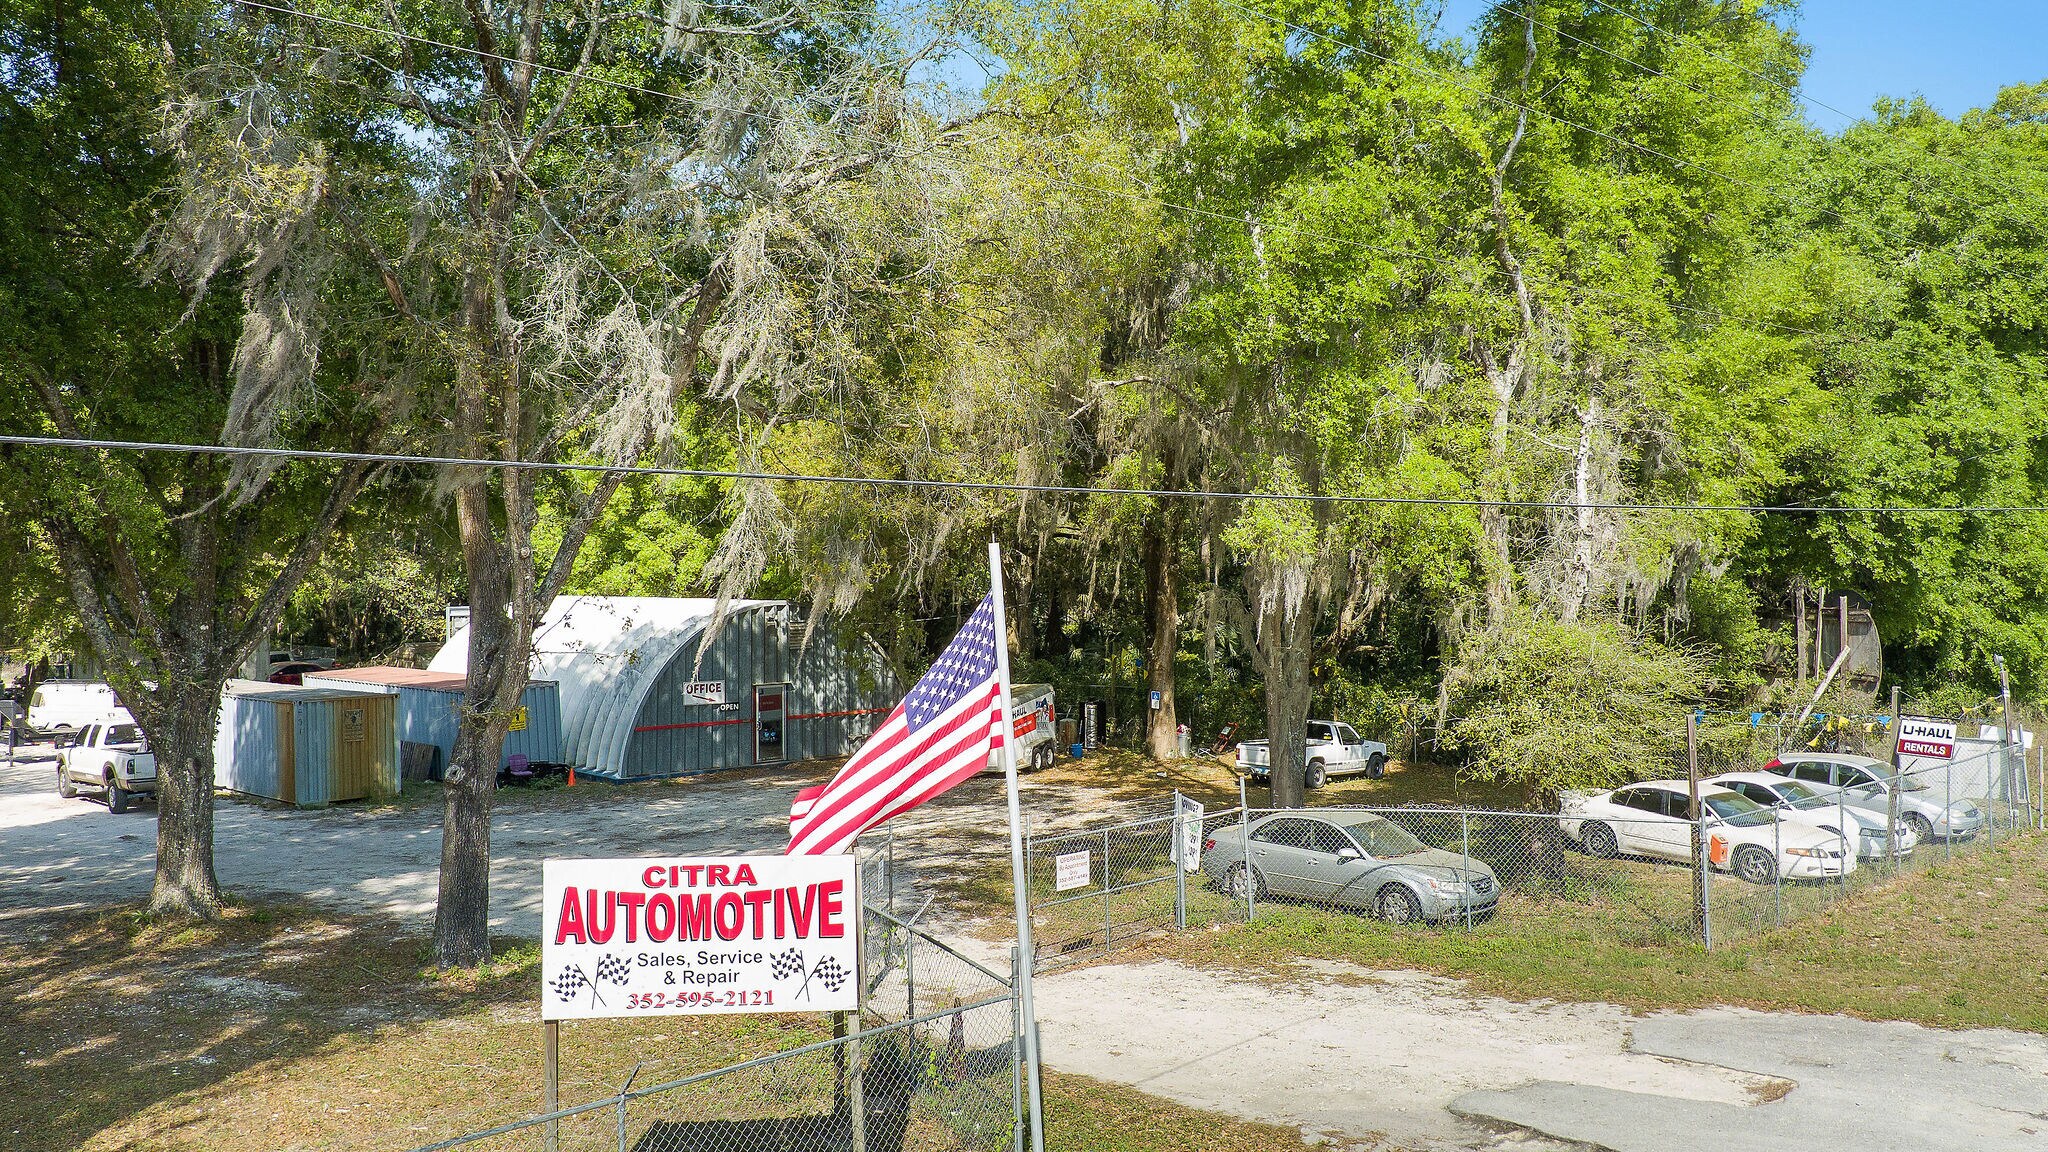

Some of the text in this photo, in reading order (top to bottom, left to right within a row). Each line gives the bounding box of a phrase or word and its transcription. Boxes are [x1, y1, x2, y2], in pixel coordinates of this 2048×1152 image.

[686, 683, 722, 694] OFFICE
[720, 703, 739, 711] OPEN
[1903, 725, 1953, 739] U-HAUL
[1903, 742, 1946, 755] RENTALS
[642, 863, 758, 888] CITRA
[555, 879, 845, 945] AUTOMOTIVE
[637, 950, 763, 968] Sales, Service
[663, 970, 741, 987] & Repair
[626, 989, 775, 1009] 352-595-2121
